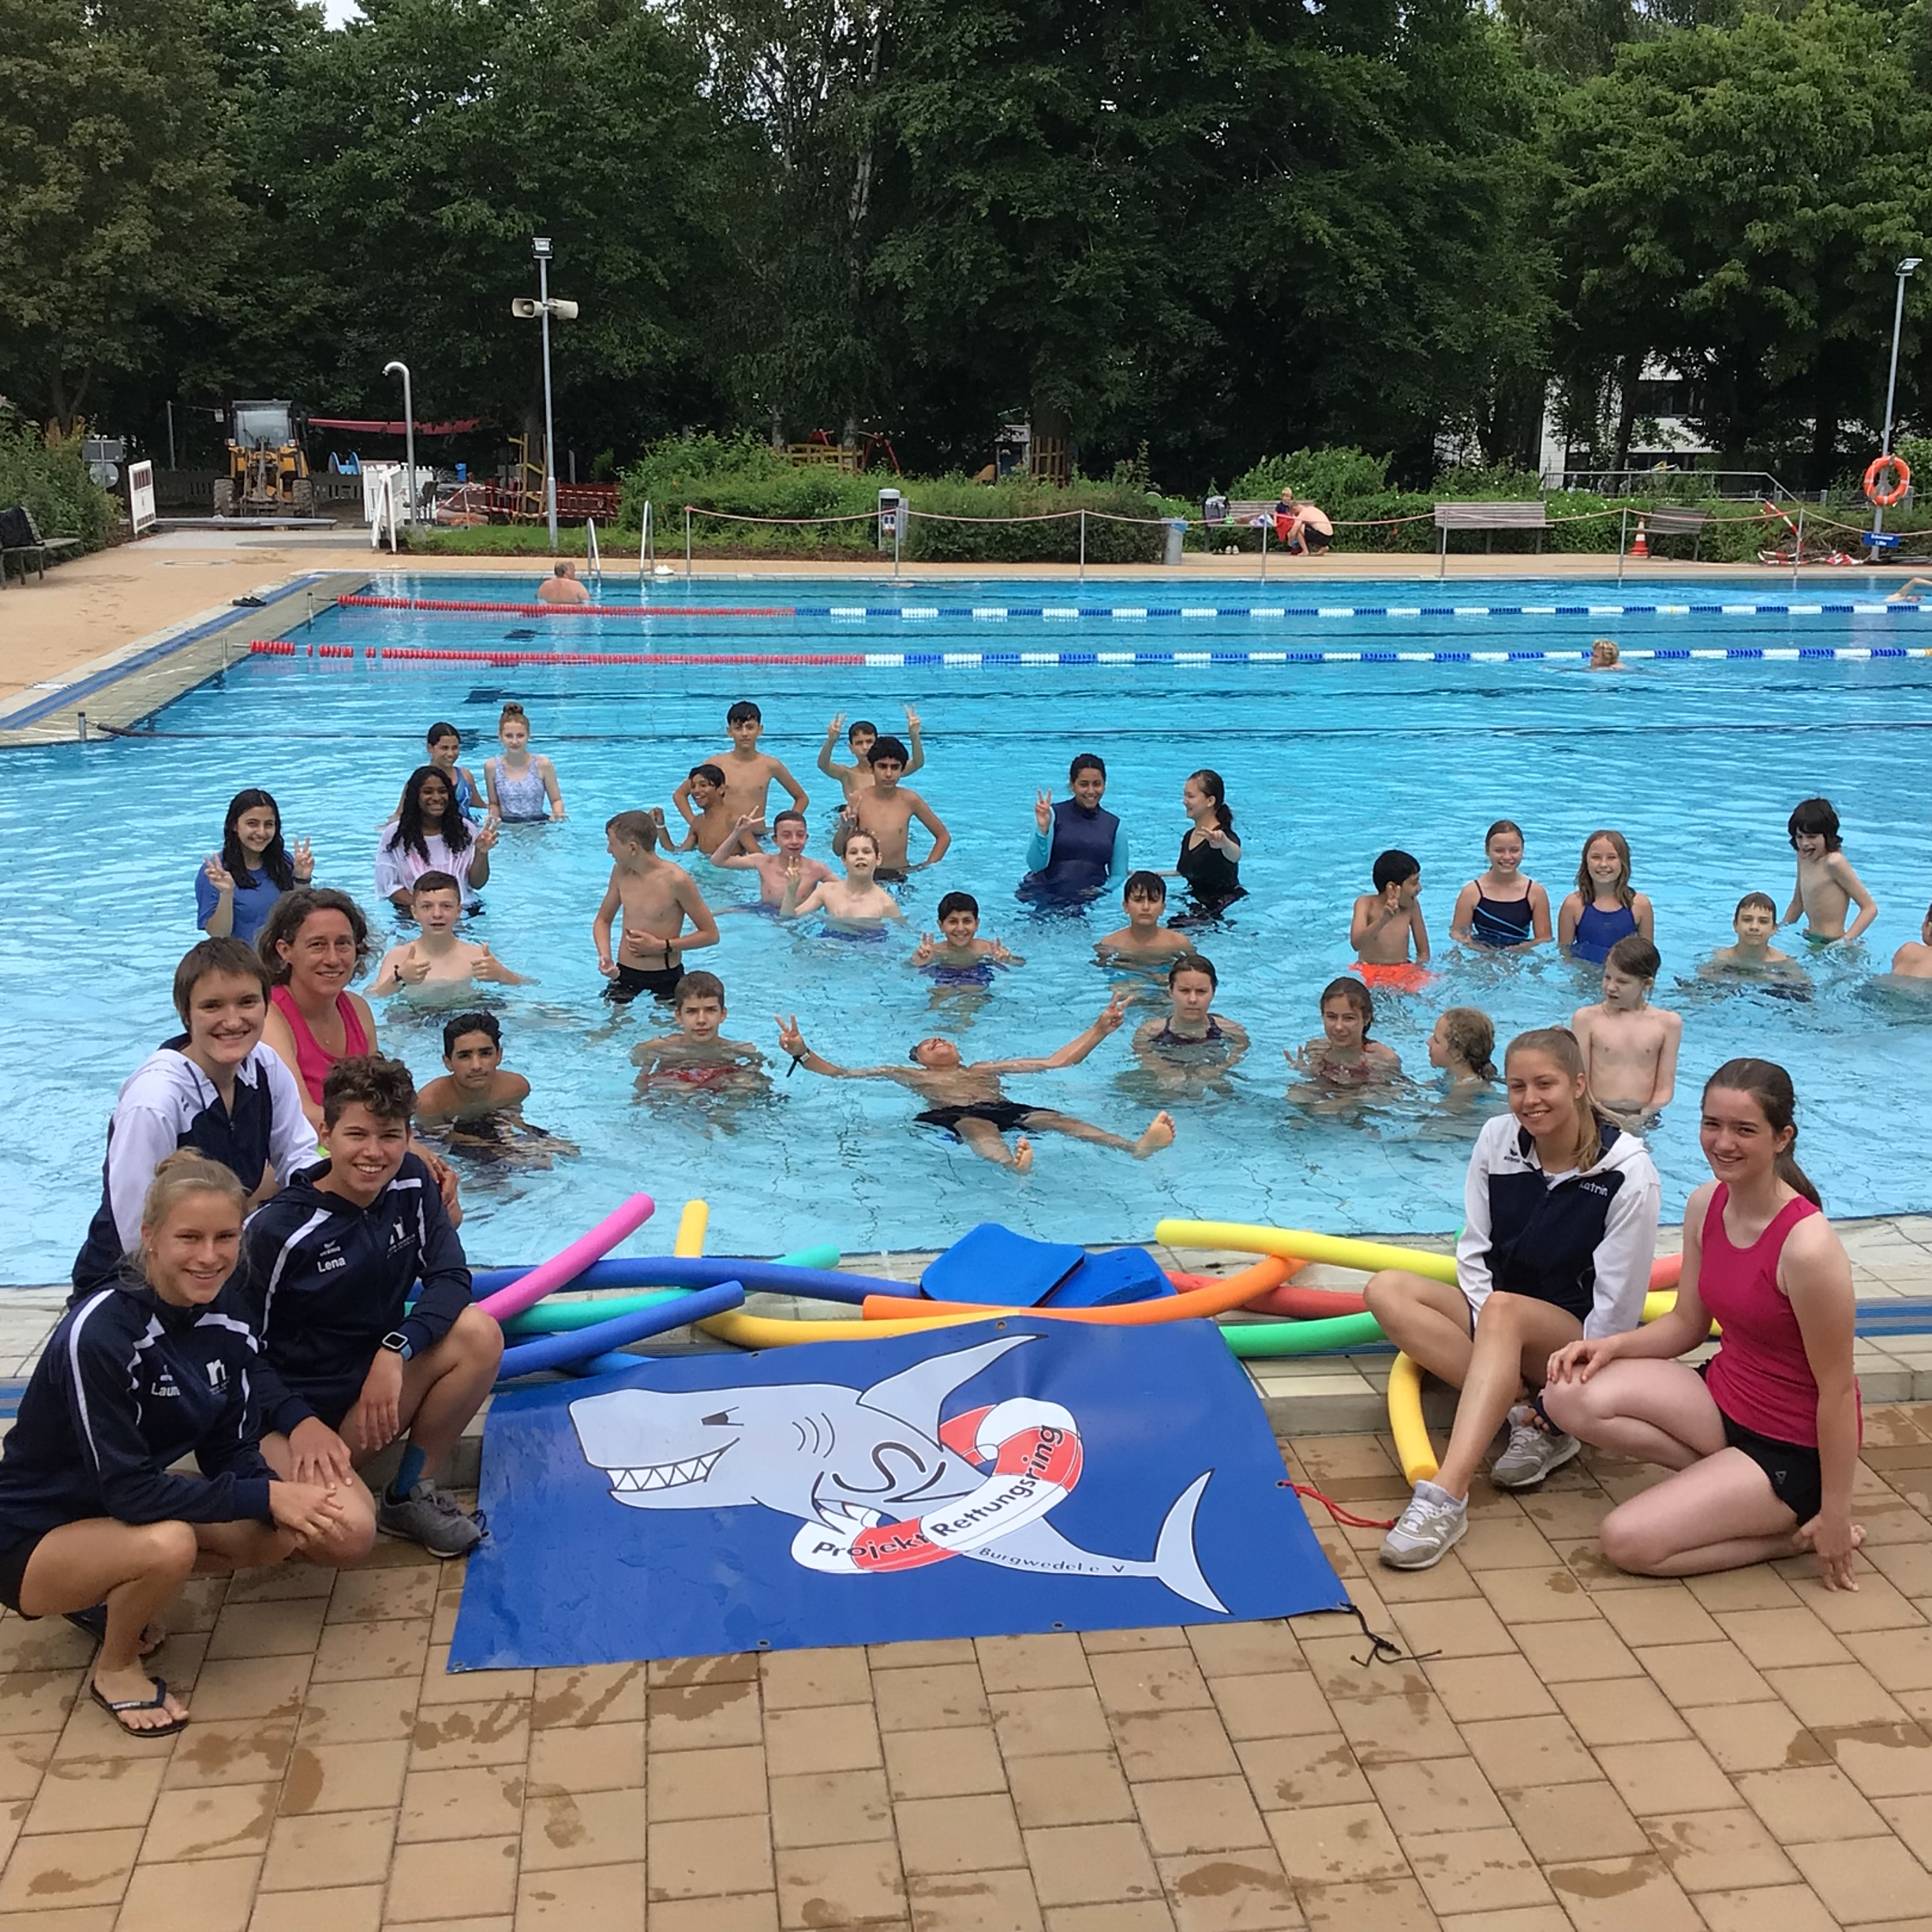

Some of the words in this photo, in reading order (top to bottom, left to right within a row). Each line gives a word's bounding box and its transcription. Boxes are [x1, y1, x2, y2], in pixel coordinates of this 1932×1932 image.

[316, 1256, 346, 1273] Lena
[811, 1533, 930, 1559] Projekt
[929, 1424, 1064, 1537] Rettungsring
[978, 1547, 1083, 1571] Burgwedel
